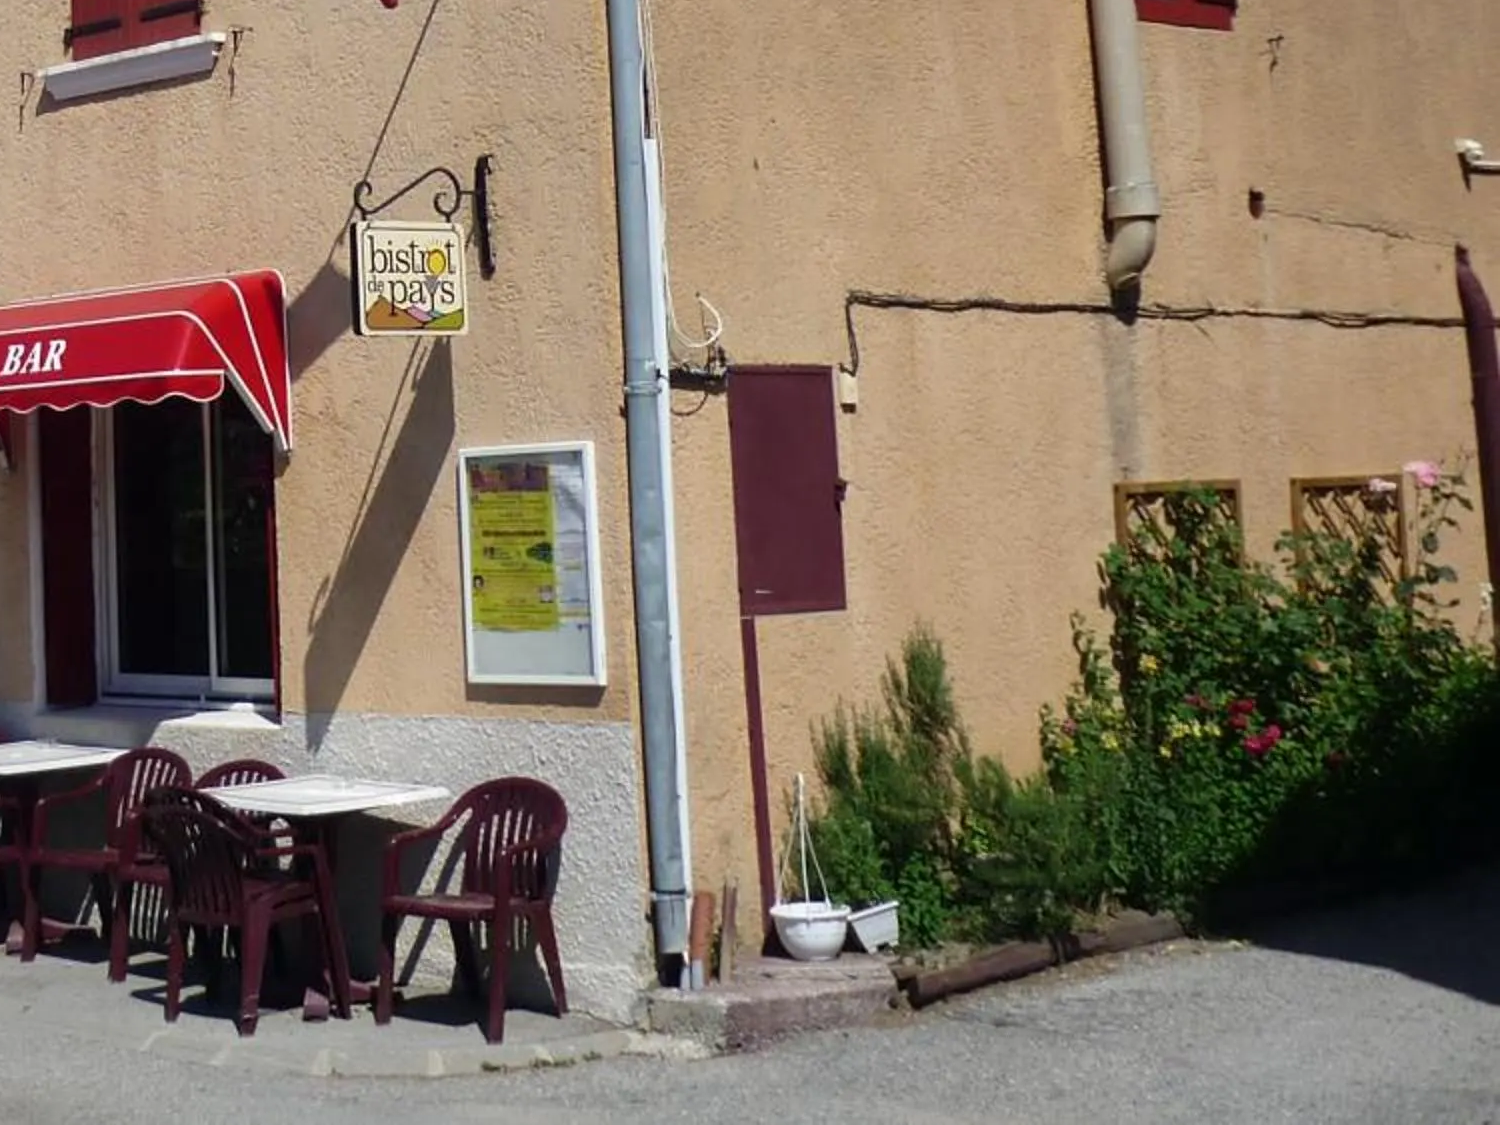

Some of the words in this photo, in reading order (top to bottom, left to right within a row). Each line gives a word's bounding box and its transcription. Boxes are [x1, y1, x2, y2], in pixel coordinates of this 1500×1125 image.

[367, 235, 456, 274] bistrot
[367, 275, 384, 293] de
[388, 277, 455, 316] pays
[0, 340, 67, 376] BAR
